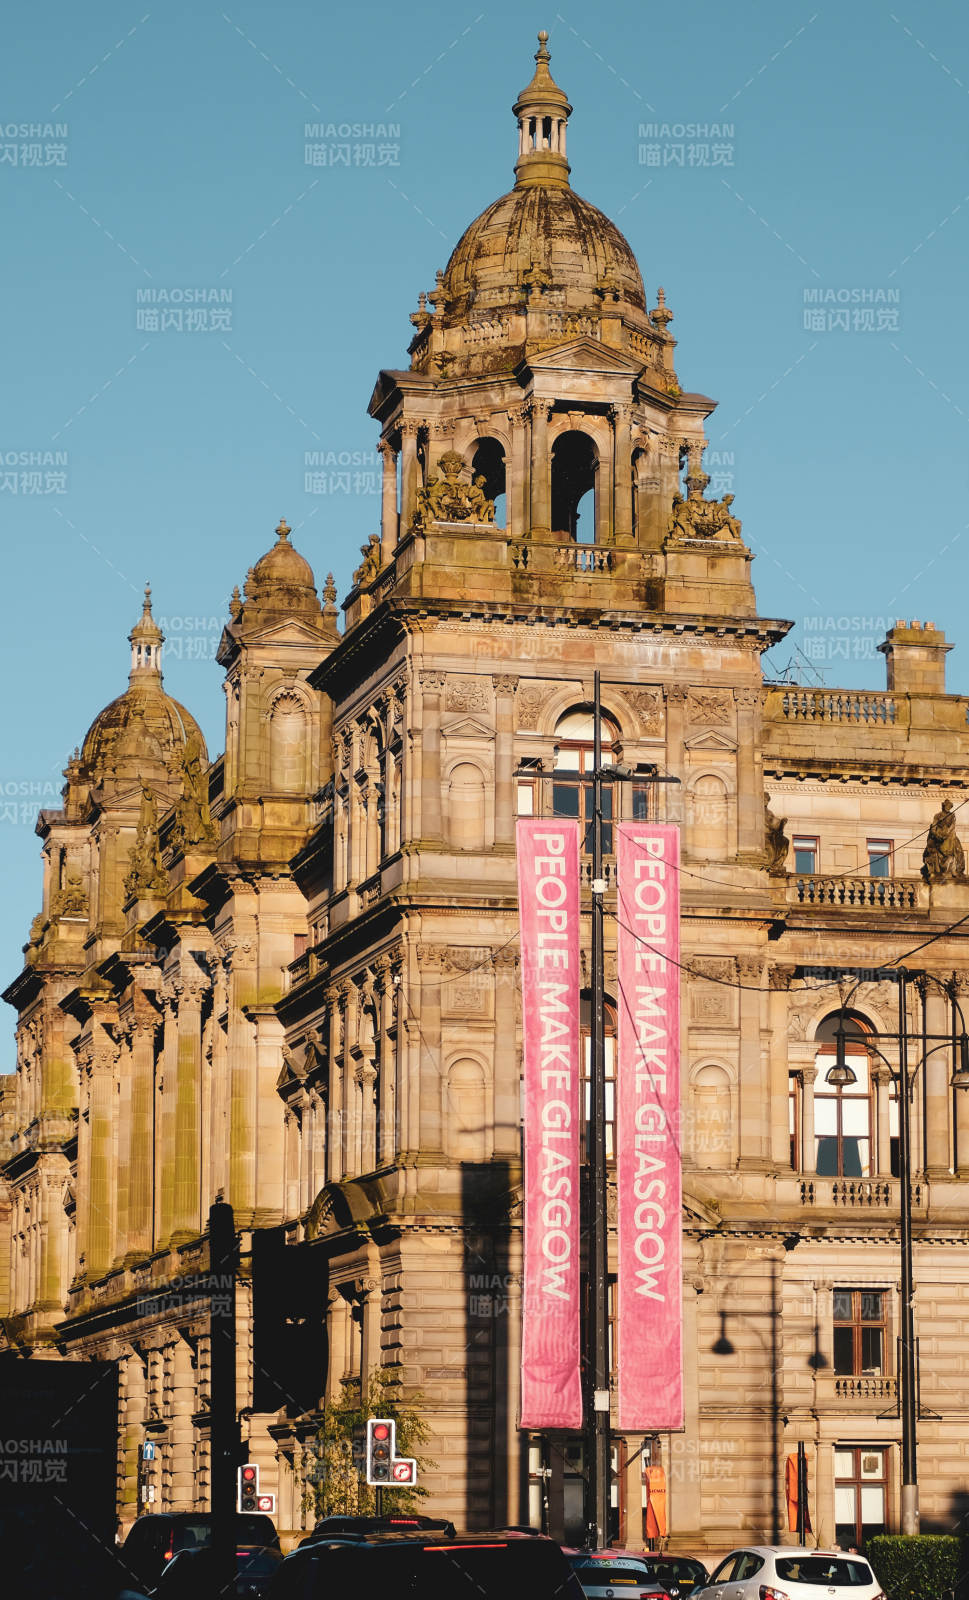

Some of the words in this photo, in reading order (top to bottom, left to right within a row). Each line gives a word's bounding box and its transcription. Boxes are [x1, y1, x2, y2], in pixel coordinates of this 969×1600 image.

[533, 833, 568, 969] PEOPLE
[632, 836, 667, 973] PEOPLE
[537, 982, 570, 1091] MAKE
[634, 985, 667, 1094] MAKE
[541, 1100, 572, 1301] GLASGOW
[633, 1103, 667, 1302] GLASGOW
